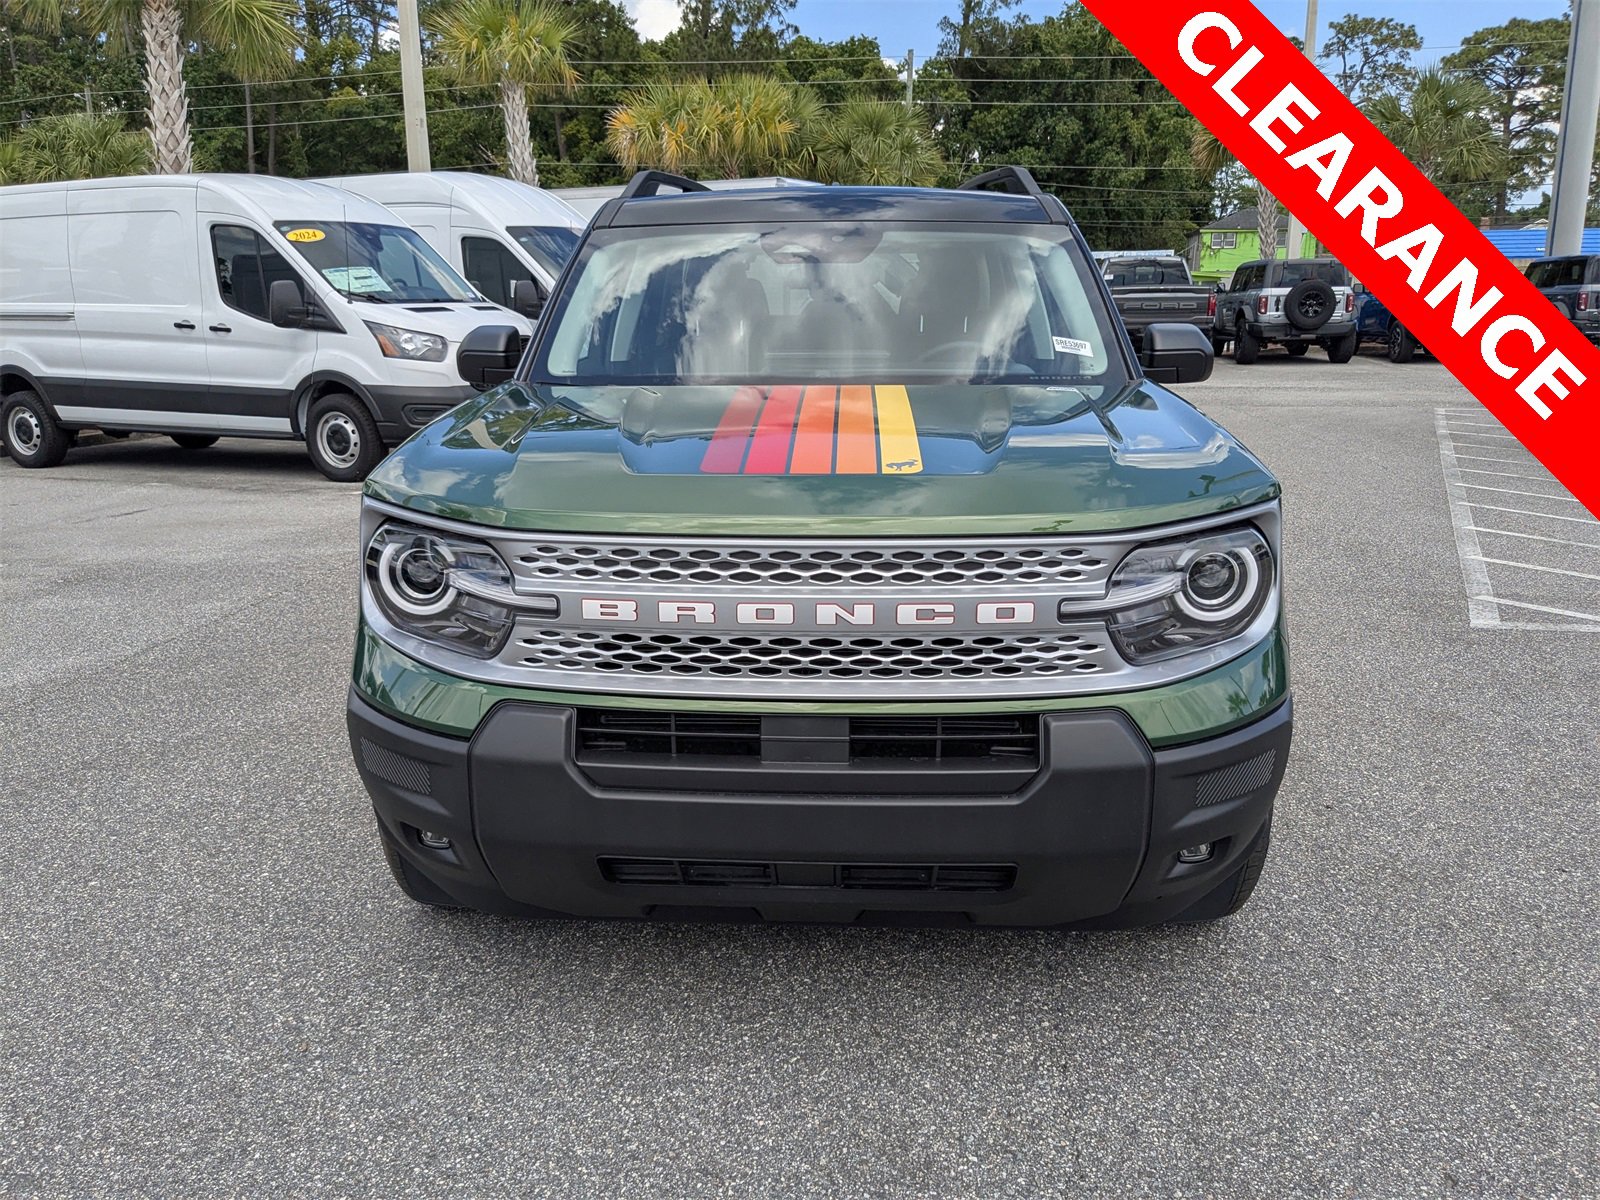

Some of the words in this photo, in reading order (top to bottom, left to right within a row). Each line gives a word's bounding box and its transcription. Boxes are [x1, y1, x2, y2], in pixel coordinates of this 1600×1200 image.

[293, 231, 317, 241] 2024
[1123, 302, 1197, 310] FORD
[581, 598, 1035, 625] BRONCO
